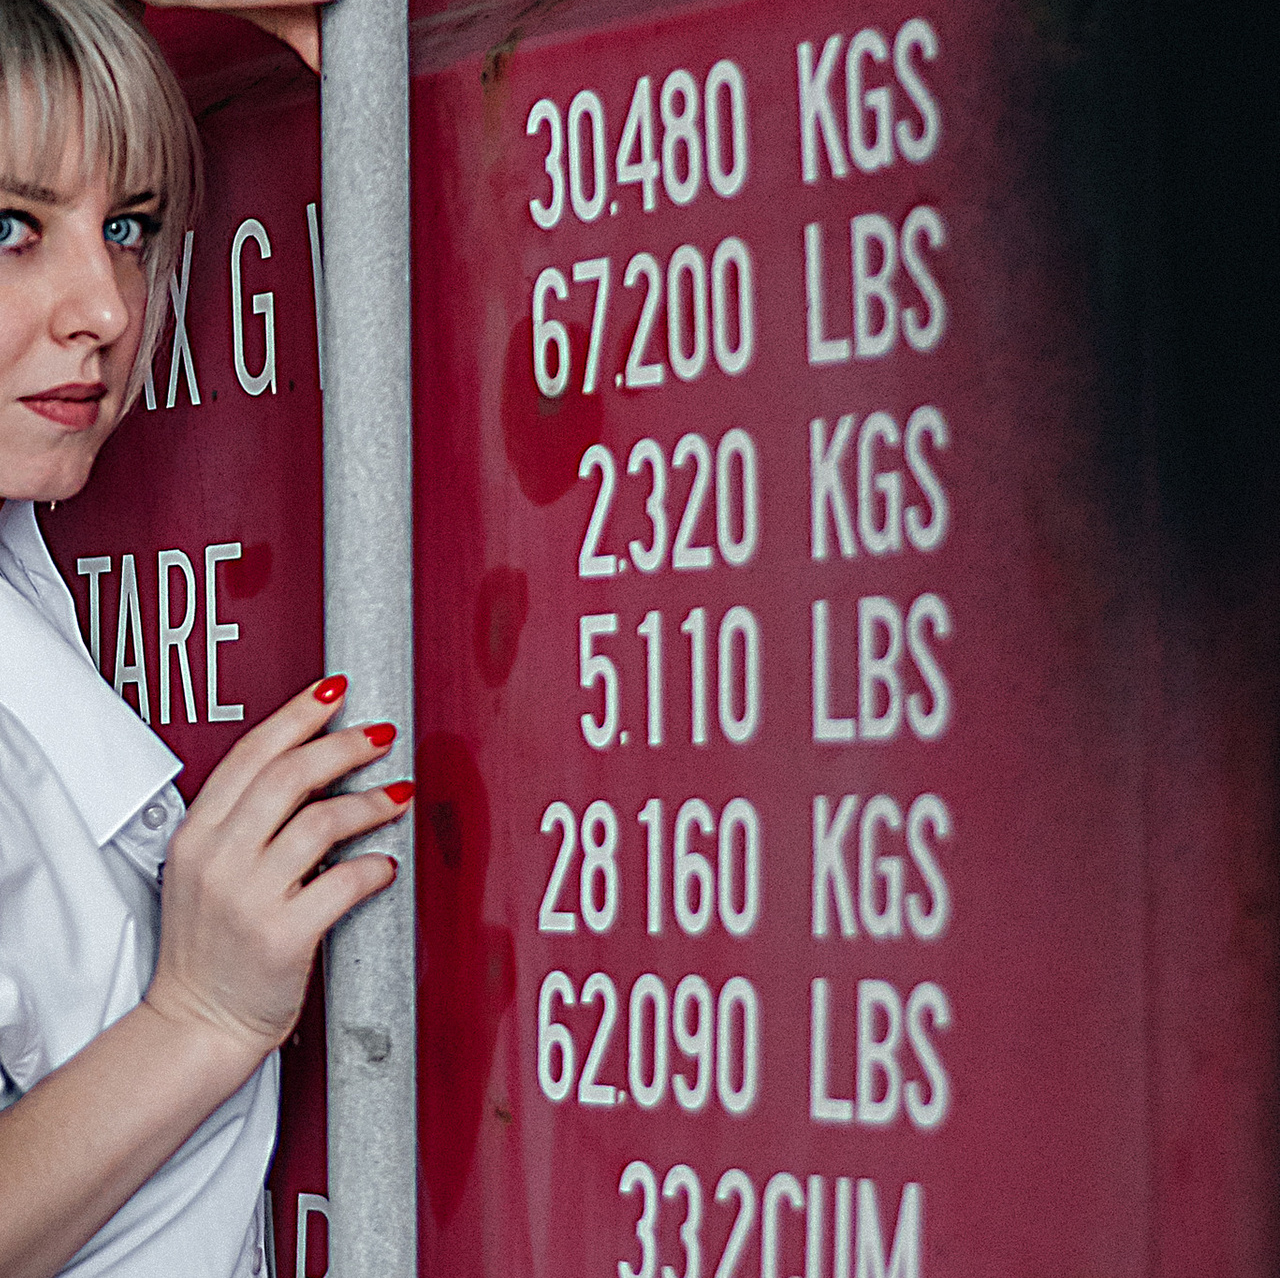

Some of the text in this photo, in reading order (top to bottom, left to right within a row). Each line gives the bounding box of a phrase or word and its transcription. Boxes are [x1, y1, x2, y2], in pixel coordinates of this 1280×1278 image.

[526, 19, 940, 229] 30.480 KGS
[532, 207, 945, 397] 67.200 LBS
[578, 406, 949, 578] 2.320 KGS
[77, 542, 245, 726] TARE
[579, 593, 951, 750] 5.110 LBS
[811, 794, 952, 941] KGS
[537, 970, 952, 1130] 62.090 LBS
